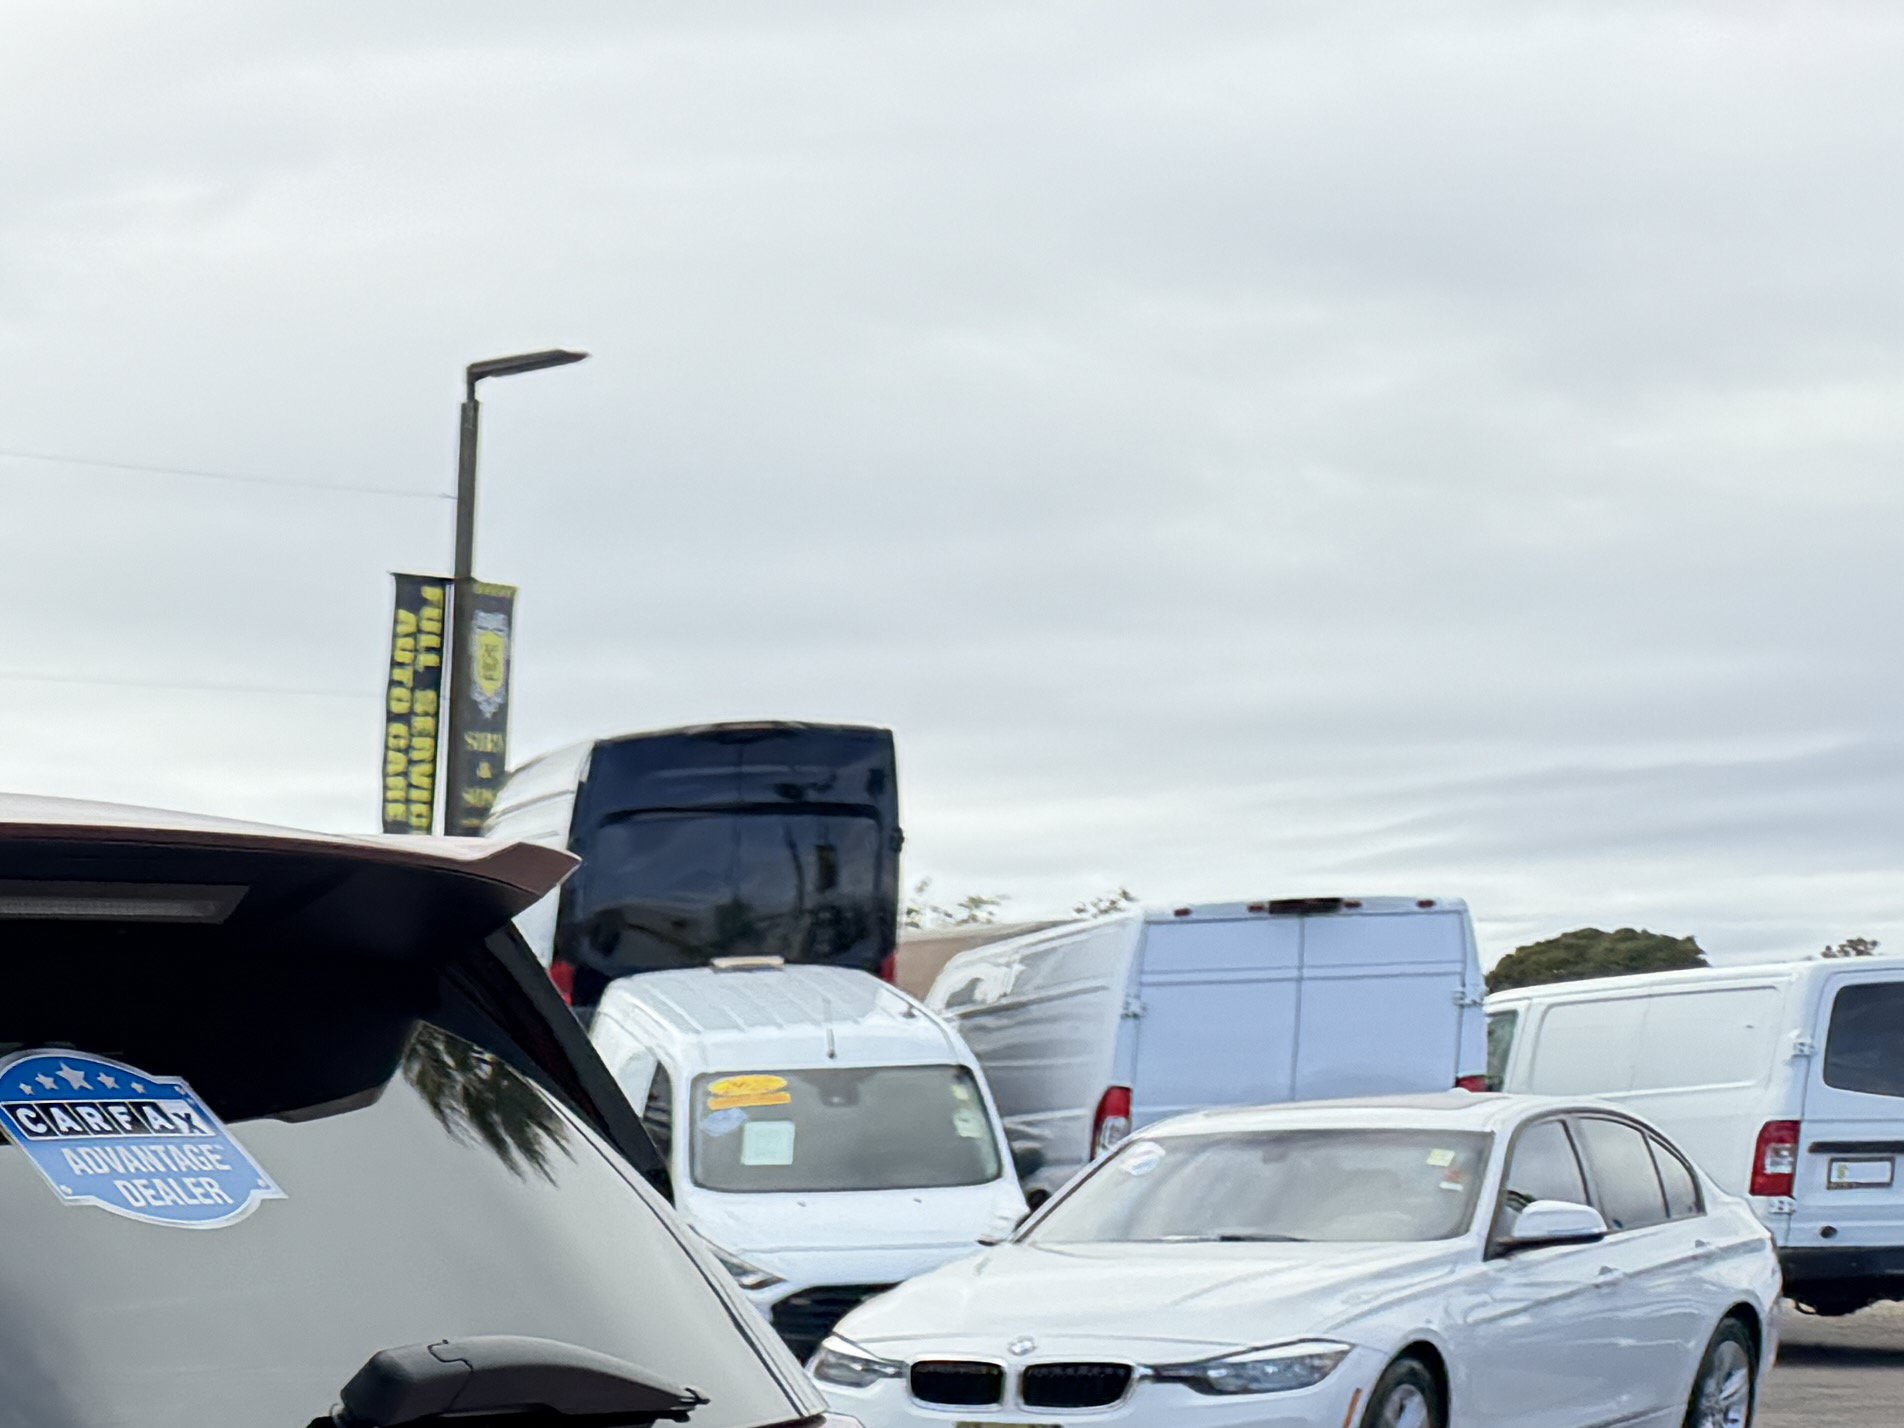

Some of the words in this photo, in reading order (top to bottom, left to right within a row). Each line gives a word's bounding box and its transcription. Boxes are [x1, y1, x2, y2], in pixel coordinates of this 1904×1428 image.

[13, 1103, 205, 1136] CARFAX
[59, 1143, 233, 1176] ADVANTAGE
[112, 1176, 236, 1208] DEALER
